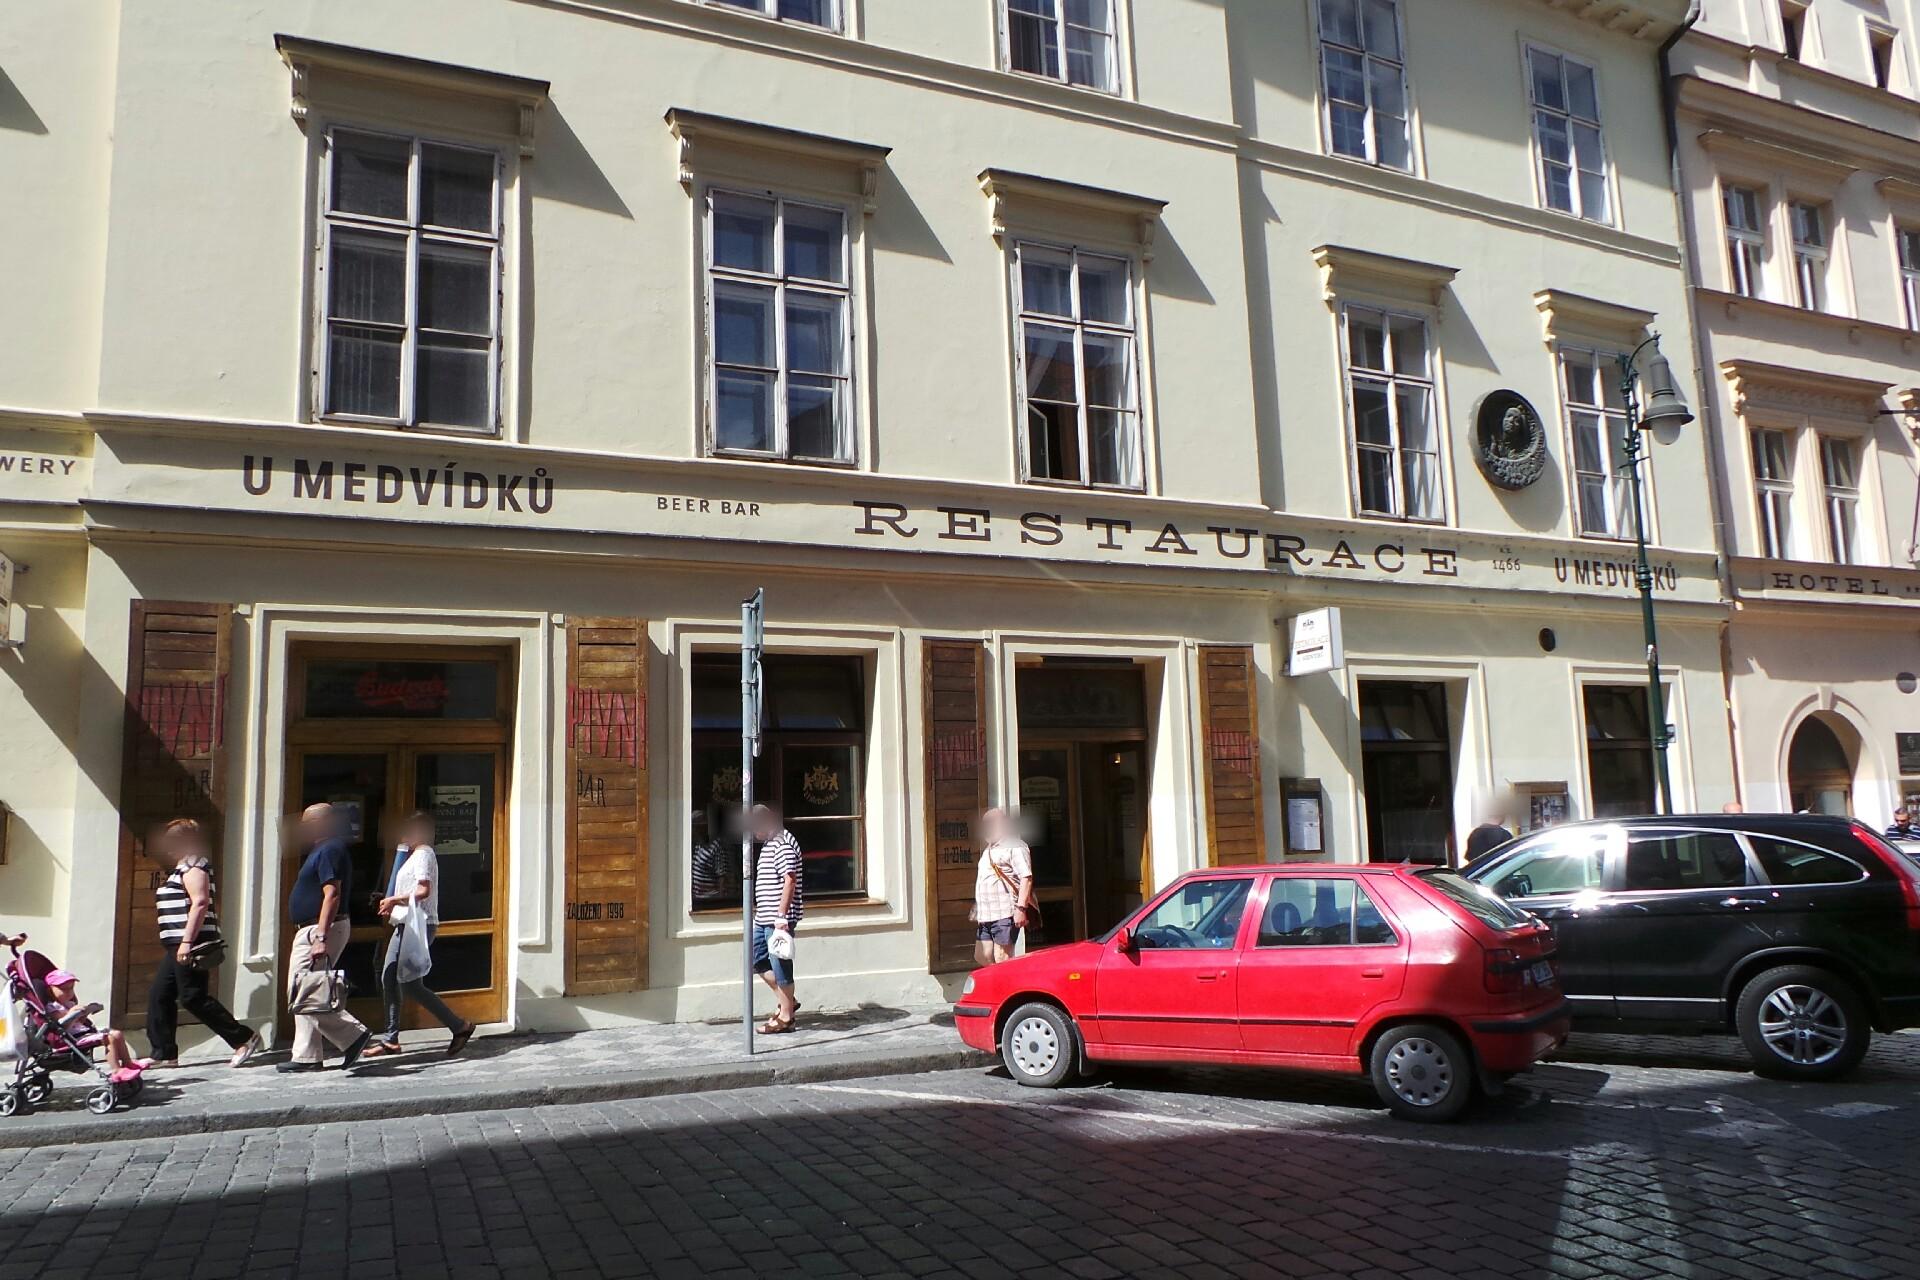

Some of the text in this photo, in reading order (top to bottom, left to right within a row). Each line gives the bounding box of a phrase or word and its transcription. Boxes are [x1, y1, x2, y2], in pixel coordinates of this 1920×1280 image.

[243, 455, 554, 514] U MEDVÍDKŮ
[657, 497, 760, 516] BEER BAR
[854, 500, 1458, 577] RESTAURACE
[1493, 558, 1520, 573] 1466
[1554, 557, 1677, 591] U MEDVÍKŮ
[1771, 572, 1888, 595] HOTEL
[576, 768, 606, 808] BAR
[607, 902, 625, 919] 1998
